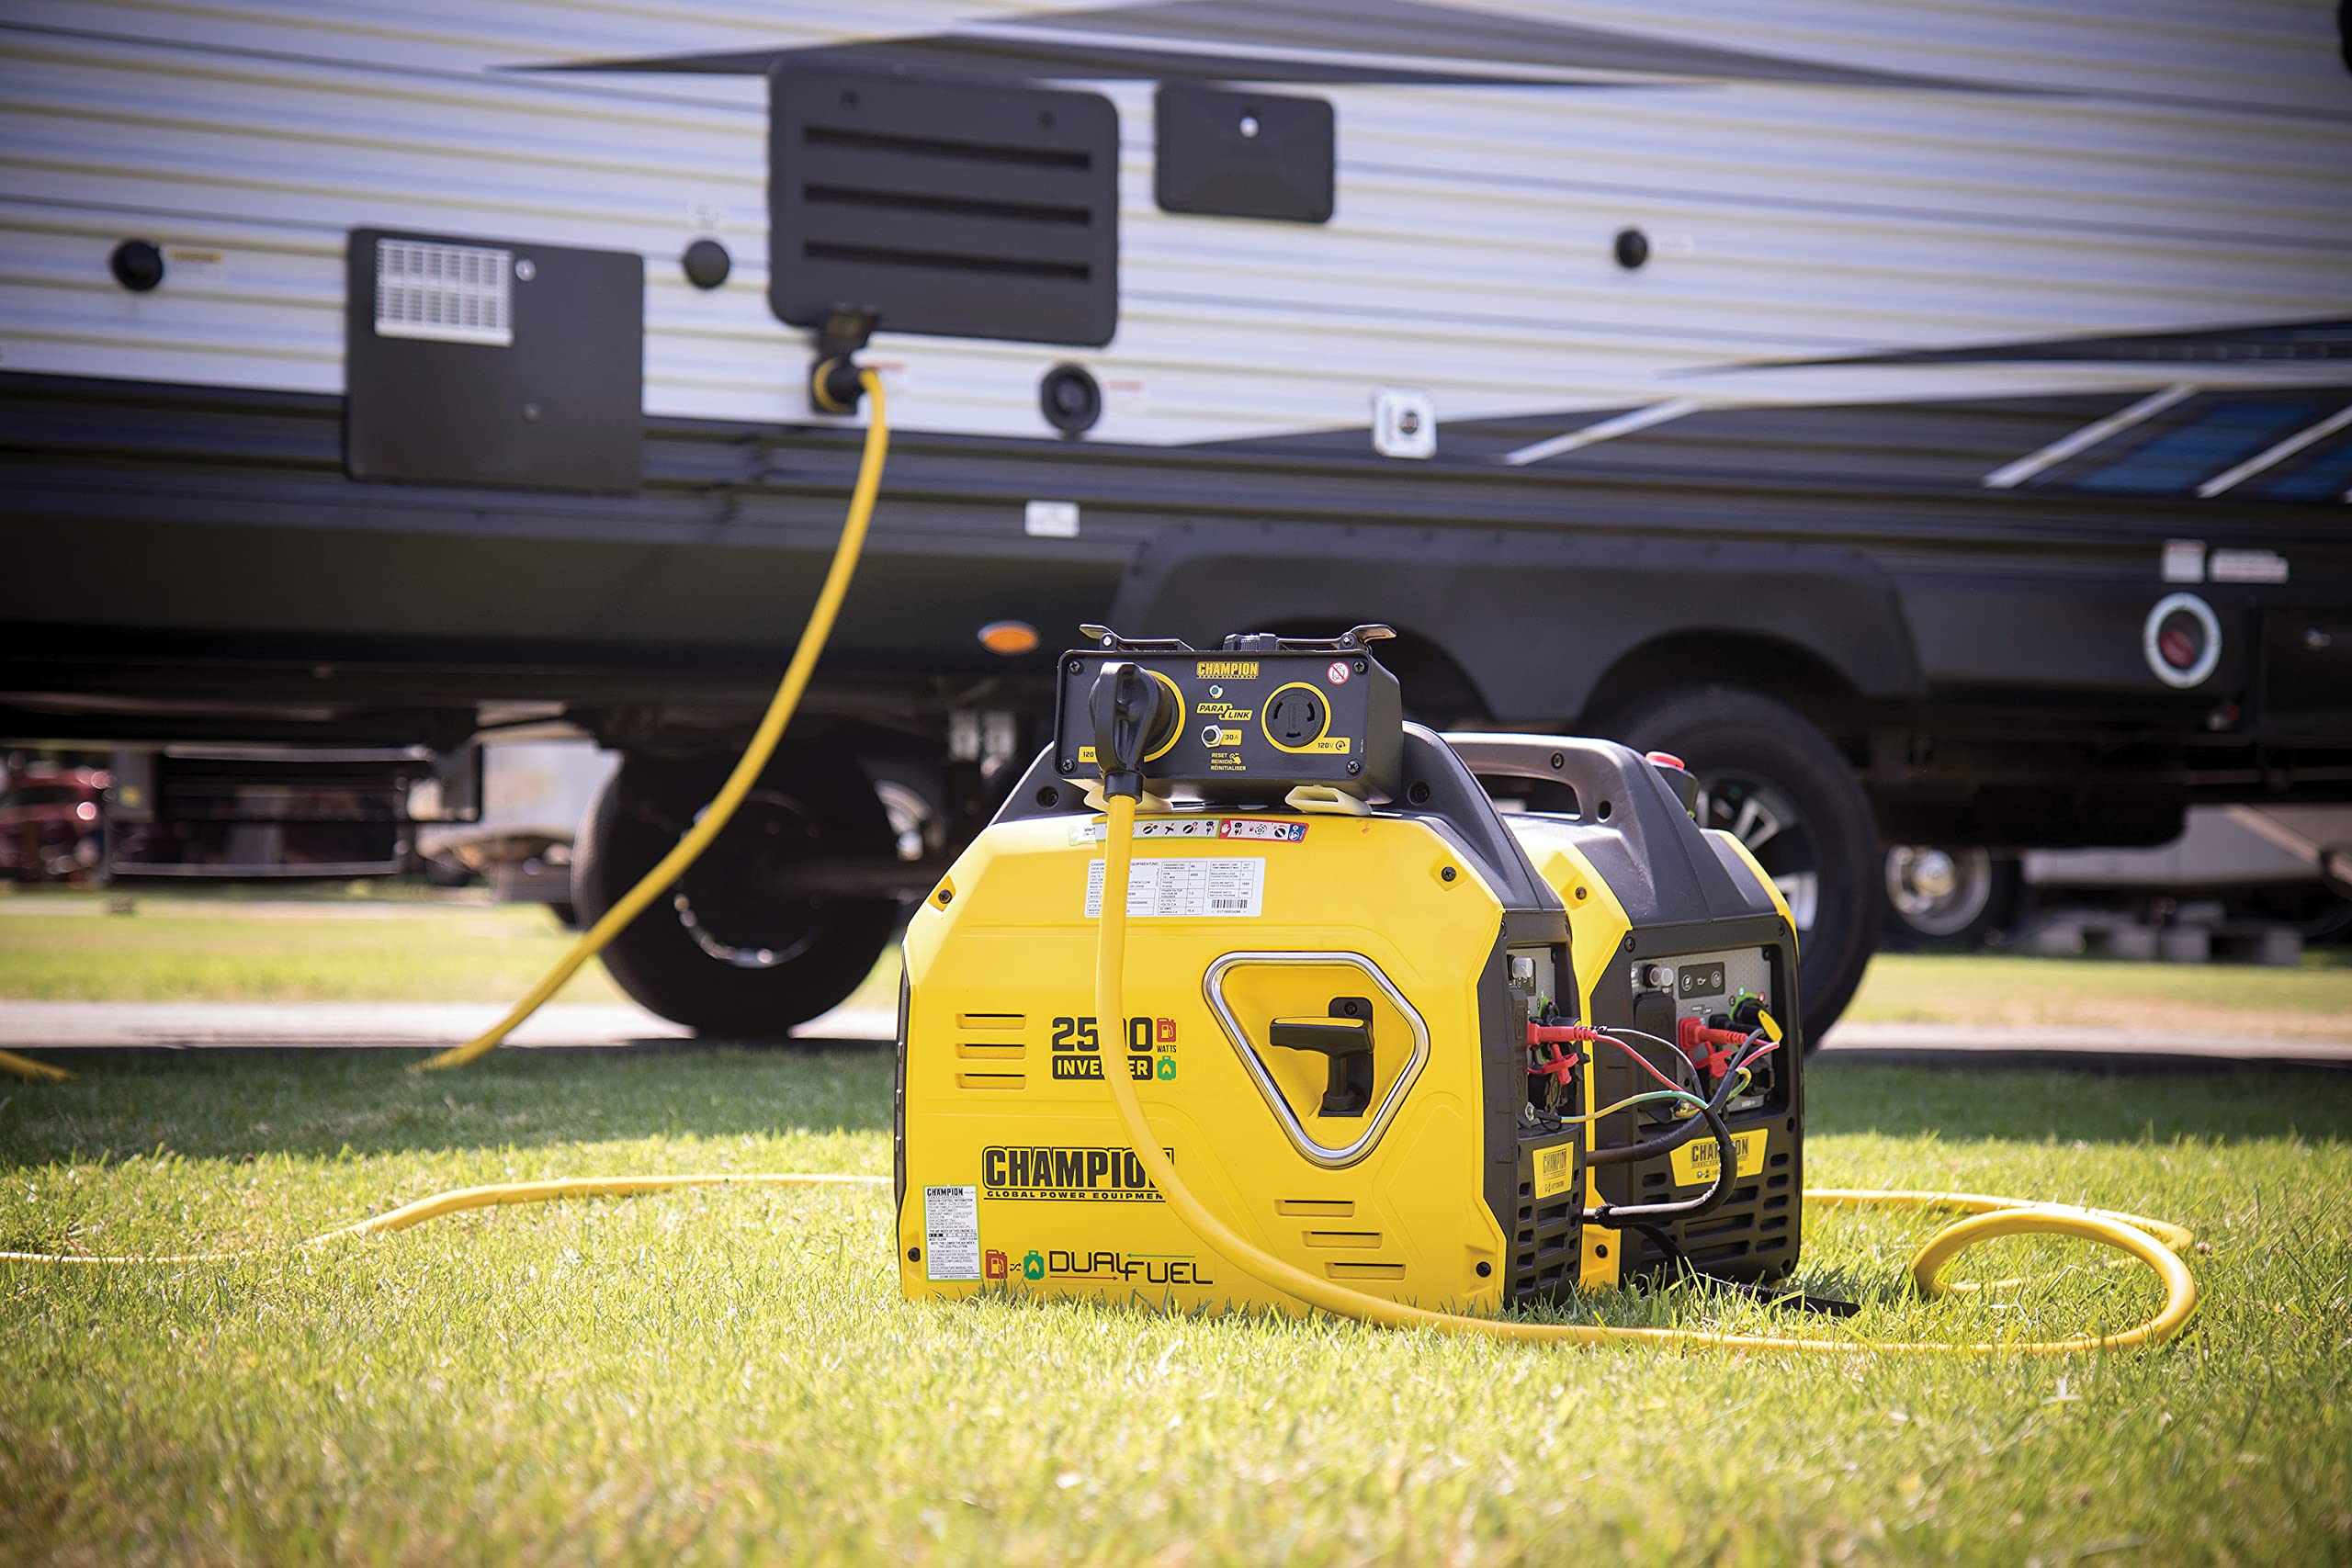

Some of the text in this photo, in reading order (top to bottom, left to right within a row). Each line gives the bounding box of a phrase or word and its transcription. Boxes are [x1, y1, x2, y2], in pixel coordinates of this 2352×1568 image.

[1197, 661, 1259, 675] CHAMPION
[1052, 1017, 1177, 1053] 250 WATTS
[1057, 1059, 1148, 1076] INVEER
[1691, 1138, 1749, 1162] CHAON
[986, 1149, 1171, 1189] CHAMPIO
[926, 1188, 964, 1196] CHAMPION
[1049, 1251, 1214, 1285] DUAL FUEL
